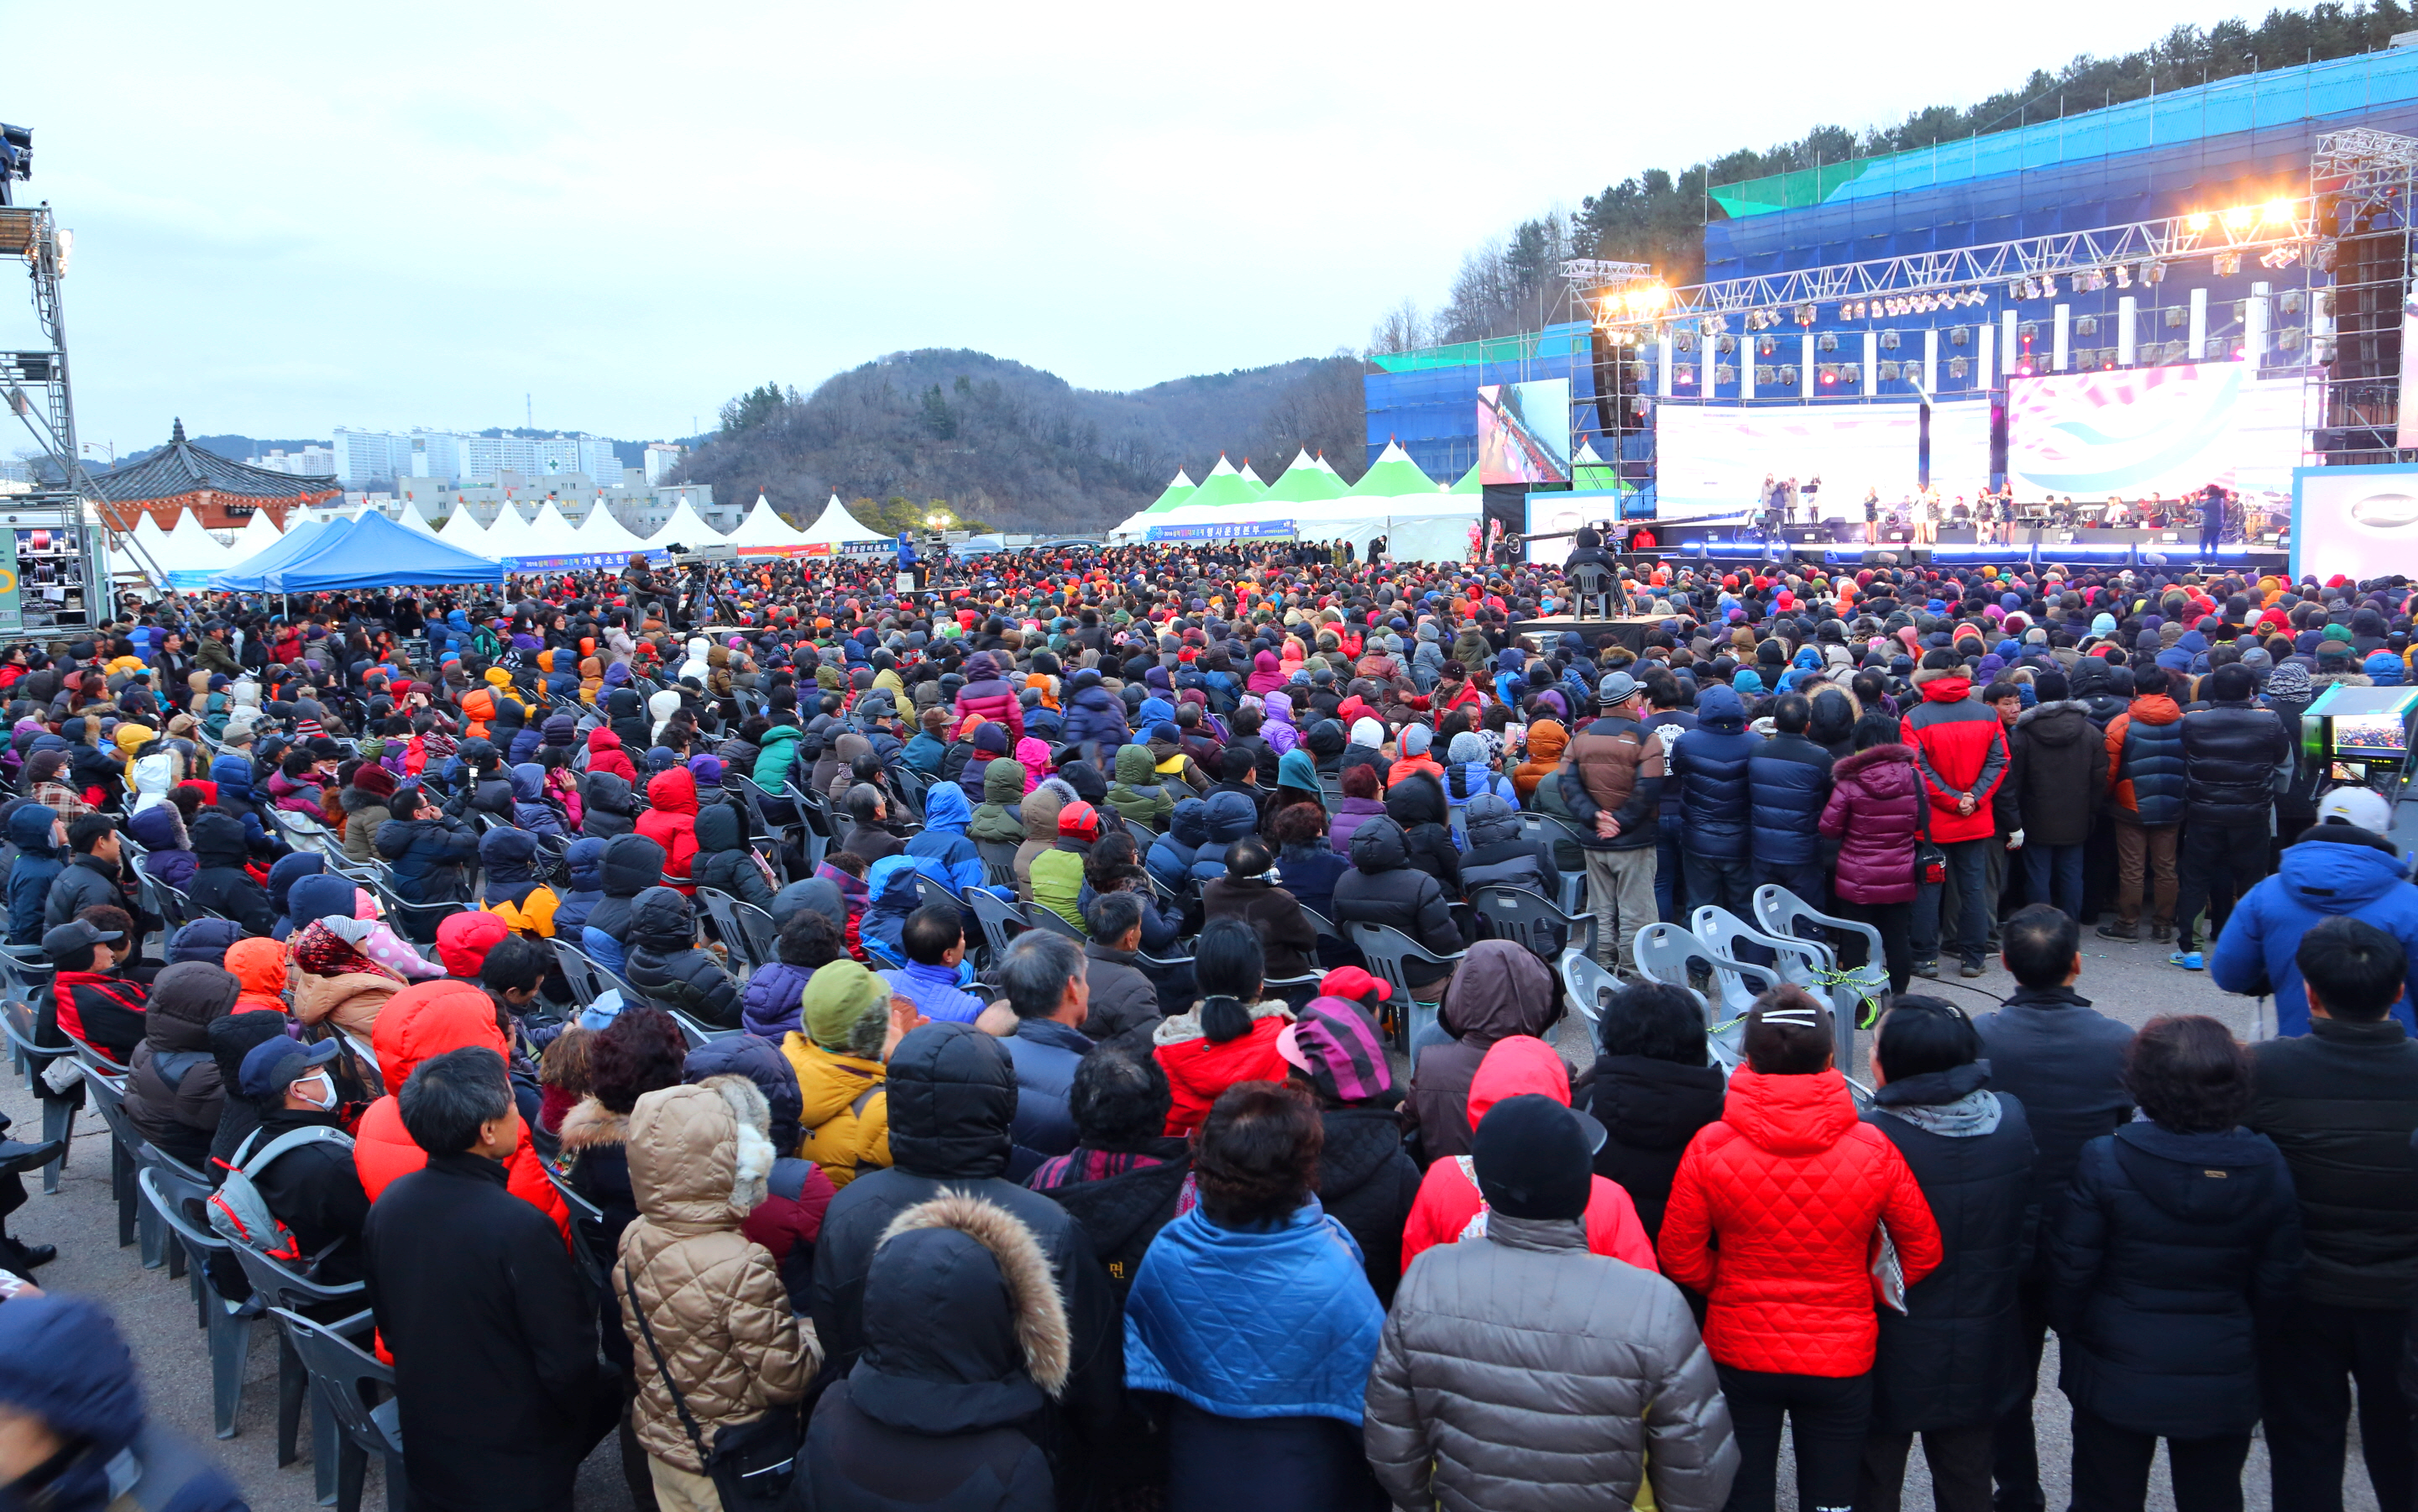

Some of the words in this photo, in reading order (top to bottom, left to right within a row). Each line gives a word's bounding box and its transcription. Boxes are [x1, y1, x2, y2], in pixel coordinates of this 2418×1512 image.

[1206, 526, 1259, 536] 행사운영본부
[845, 544, 889, 553] 경찰경비본부
[583, 553, 645, 566] 가족소원
[1109, 1261, 1124, 1279] 면
